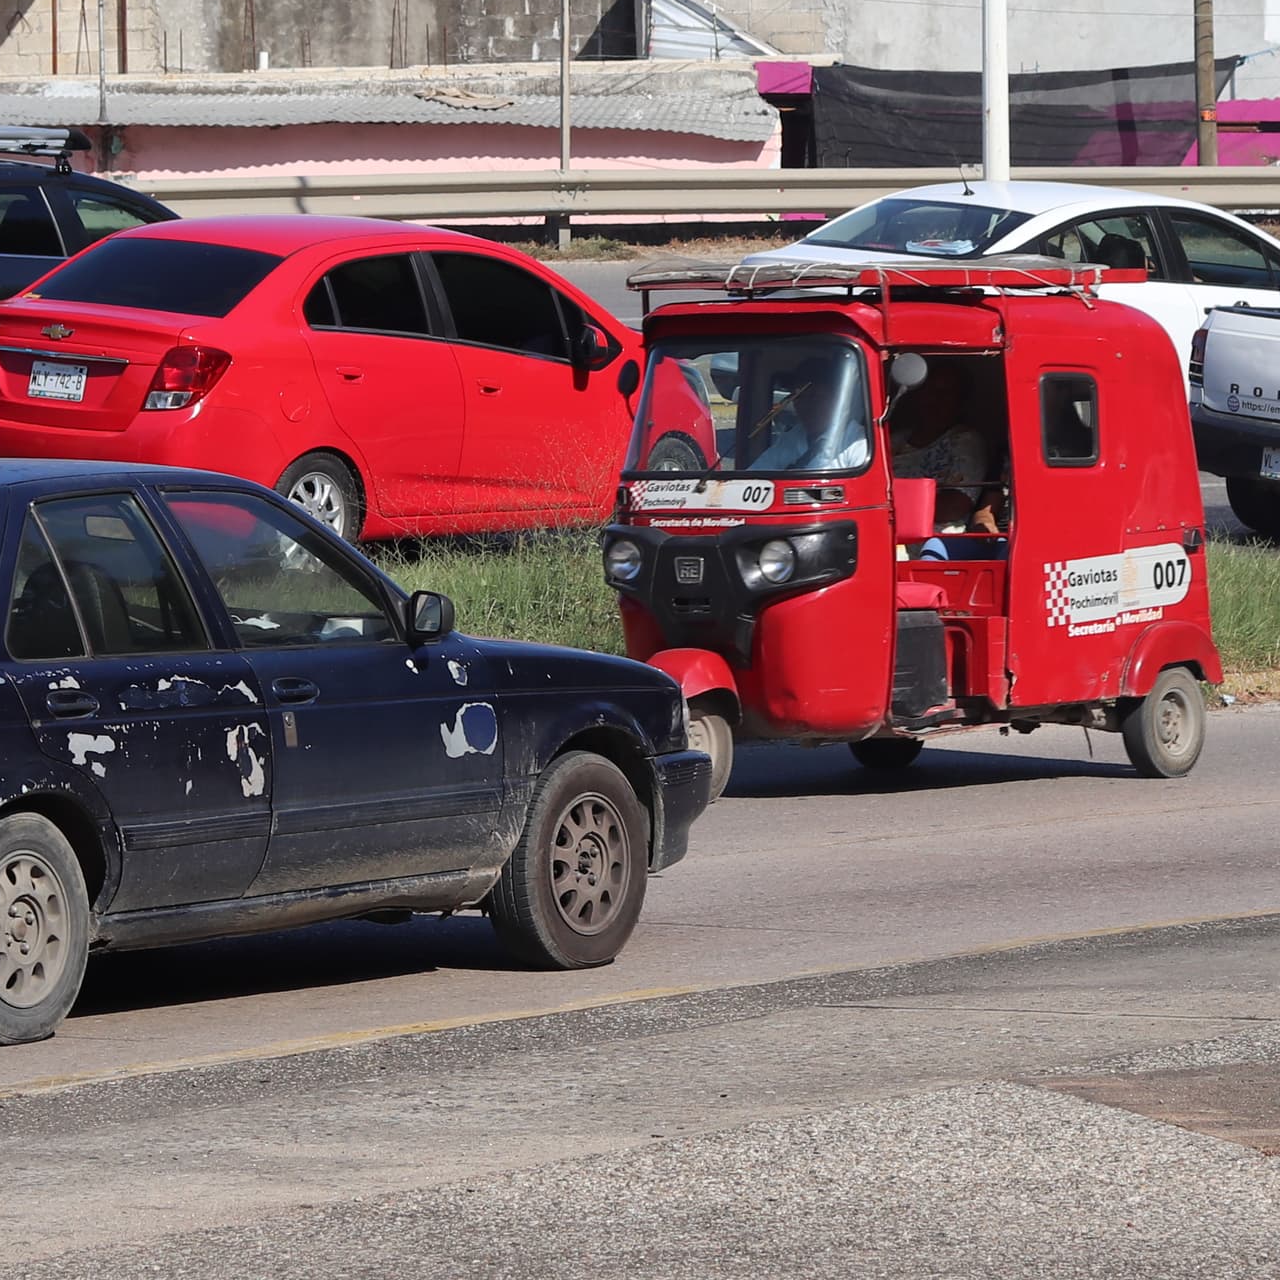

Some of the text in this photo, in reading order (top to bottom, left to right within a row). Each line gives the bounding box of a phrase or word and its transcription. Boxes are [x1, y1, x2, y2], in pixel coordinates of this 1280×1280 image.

[31, 370, 82, 390] WLY-742-B
[646, 482, 771, 504] Gaviotas 007
[692, 518, 703, 527] de
[1067, 568, 1118, 588] Gaviotas
[1153, 558, 1187, 590] 007
[1067, 620, 1116, 638] Secretaría
[1122, 606, 1164, 625] Movilidad
